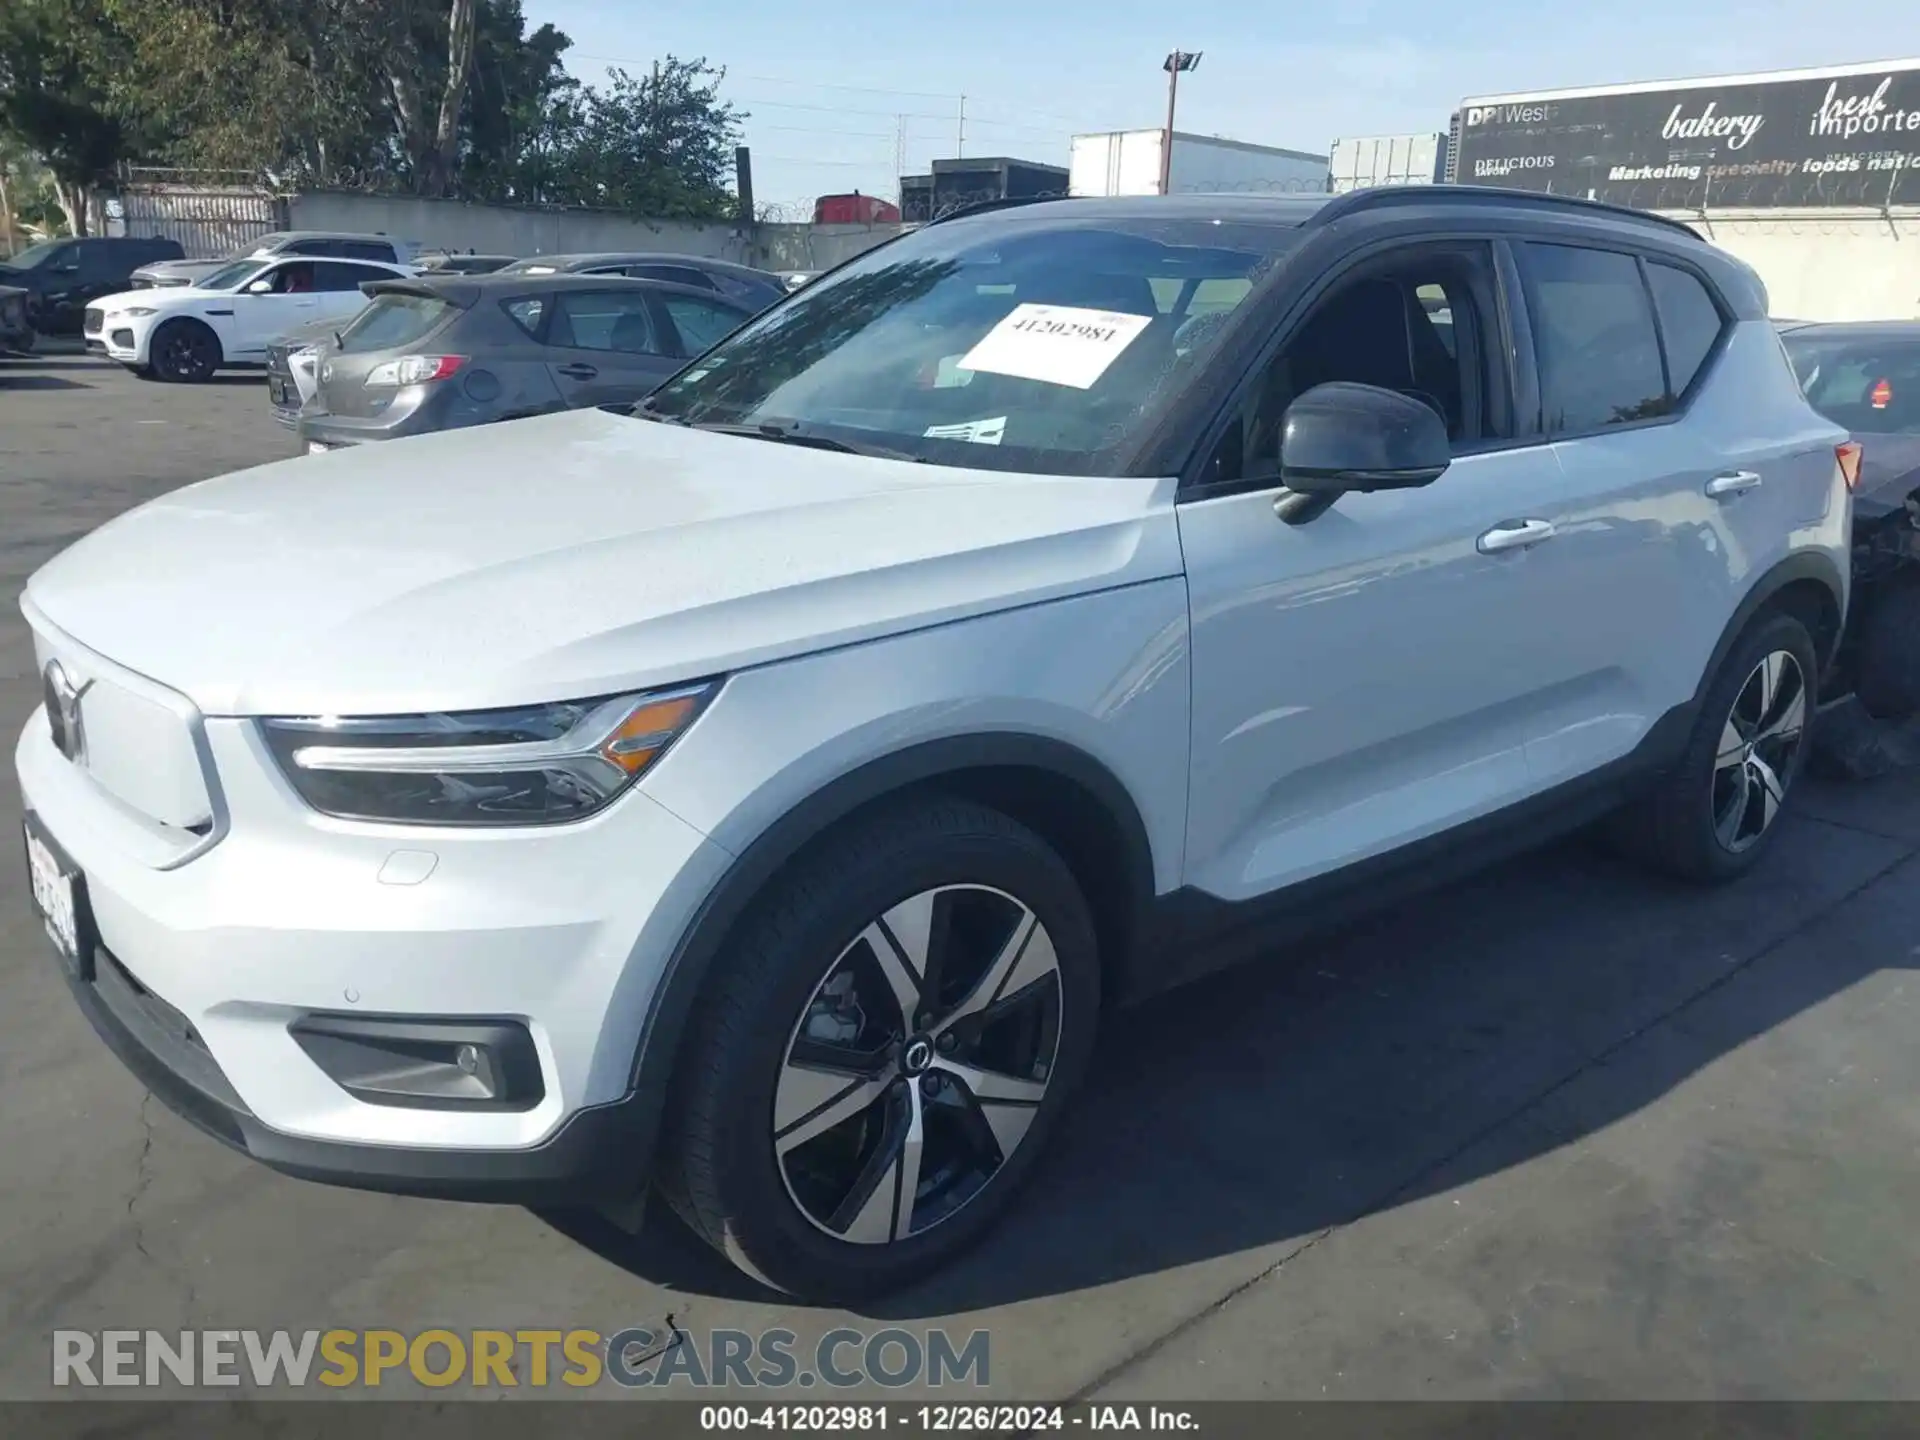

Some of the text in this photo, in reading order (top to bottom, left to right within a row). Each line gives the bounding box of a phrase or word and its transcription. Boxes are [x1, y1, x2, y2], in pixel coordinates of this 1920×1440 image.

[1505, 104, 1549, 123] West
[1661, 102, 1766, 150] bakery
[1475, 156, 1555, 171] DELICIOUS
[1608, 163, 1701, 181] Marketing
[1705, 158, 1797, 177] specialty
[1802, 157, 1861, 173] foods
[1012, 319, 1117, 342] 41202981
